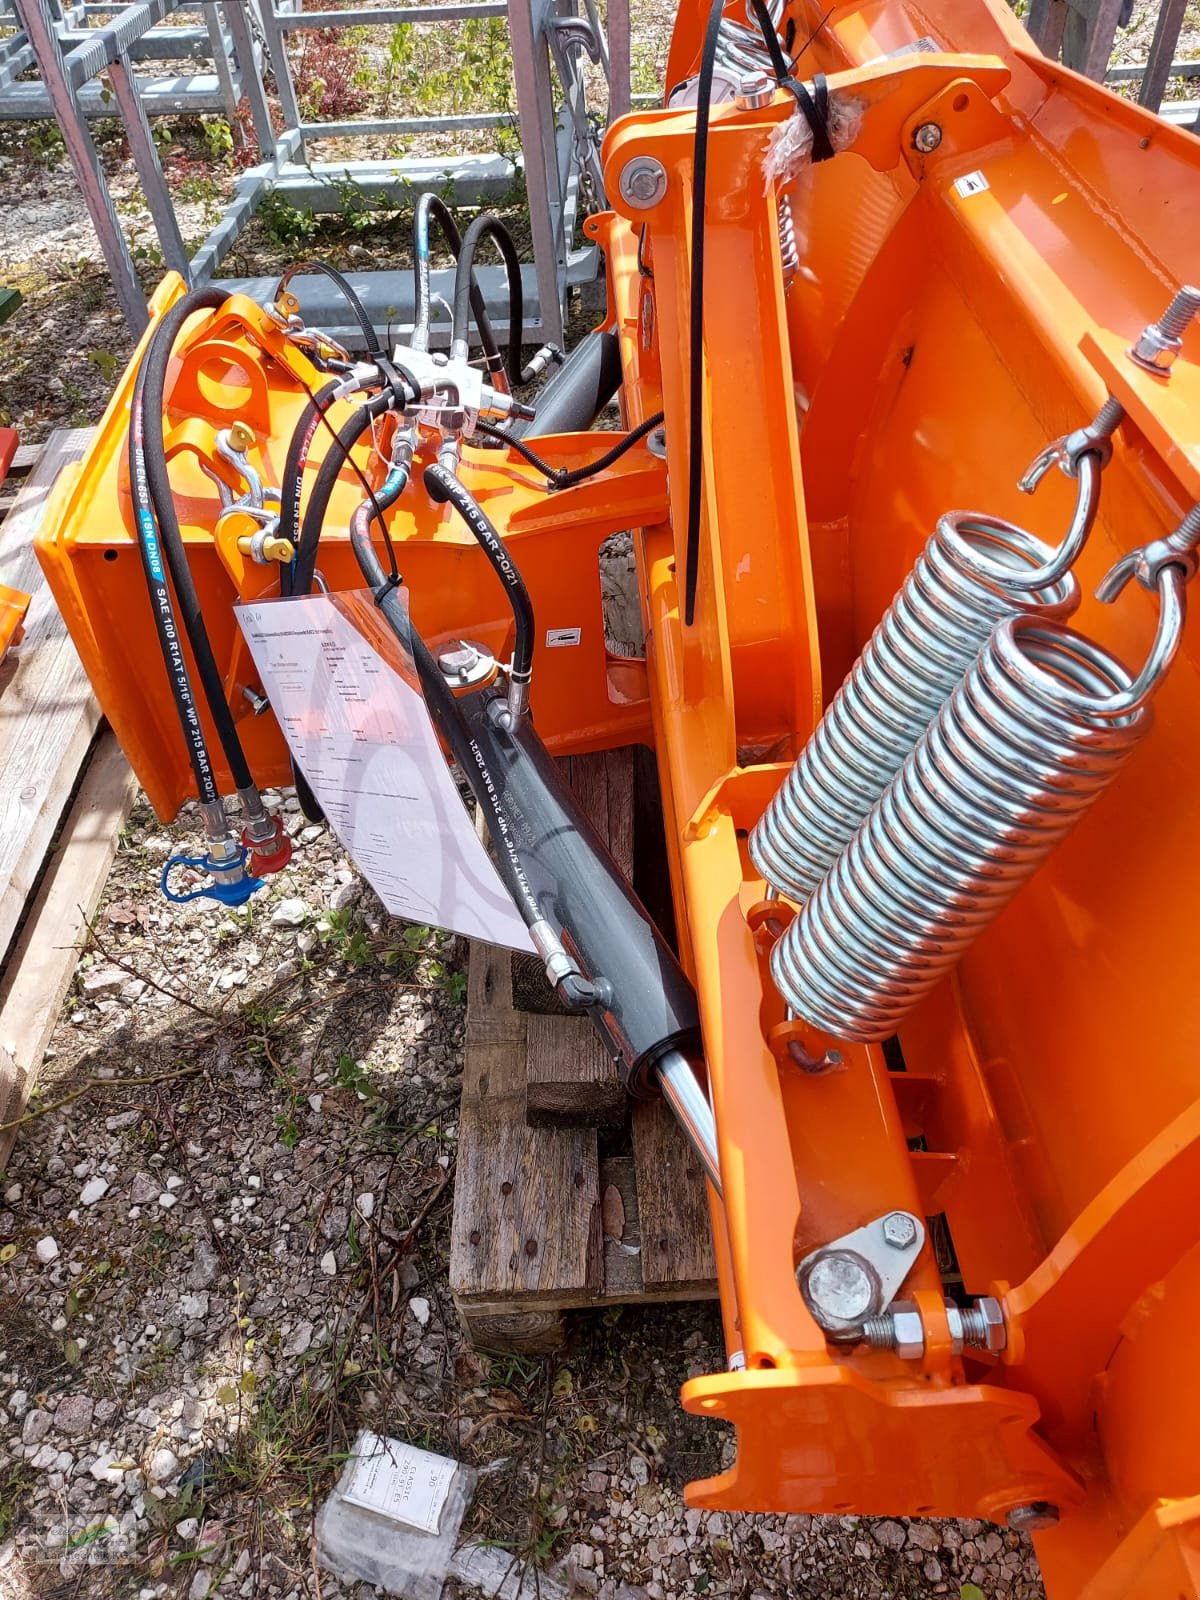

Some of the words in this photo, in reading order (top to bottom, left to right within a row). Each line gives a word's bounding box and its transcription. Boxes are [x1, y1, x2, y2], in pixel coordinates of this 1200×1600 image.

[136, 448, 144, 466] DIN
[136, 467, 146, 483] EN
[295, 476, 303, 498] DIN
[293, 502, 300, 518] EN
[143, 517, 154, 539] 1SN
[447, 480, 462, 495] WP
[460, 495, 479, 519] 215
[477, 521, 498, 551] BAR
[496, 553, 518, 586] 2Q/21
[149, 542, 161, 573] DN08
[157, 588, 170, 614] SAE
[163, 617, 176, 638] 100
[169, 641, 184, 673] R1AT
[177, 677, 192, 704] 5/16"
[186, 707, 198, 727] WP
[191, 729, 203, 749] 215
[196, 750, 210, 775] BAR
[469, 739, 486, 768] 2Q/21
[481, 771, 495, 793] BAR
[491, 796, 502, 814] 215
[497, 815, 508, 835] WP
[504, 837, 519, 865] 5/16"
[513, 868, 531, 896] R1AT
[403, 1466, 417, 1501] CLASSIC
